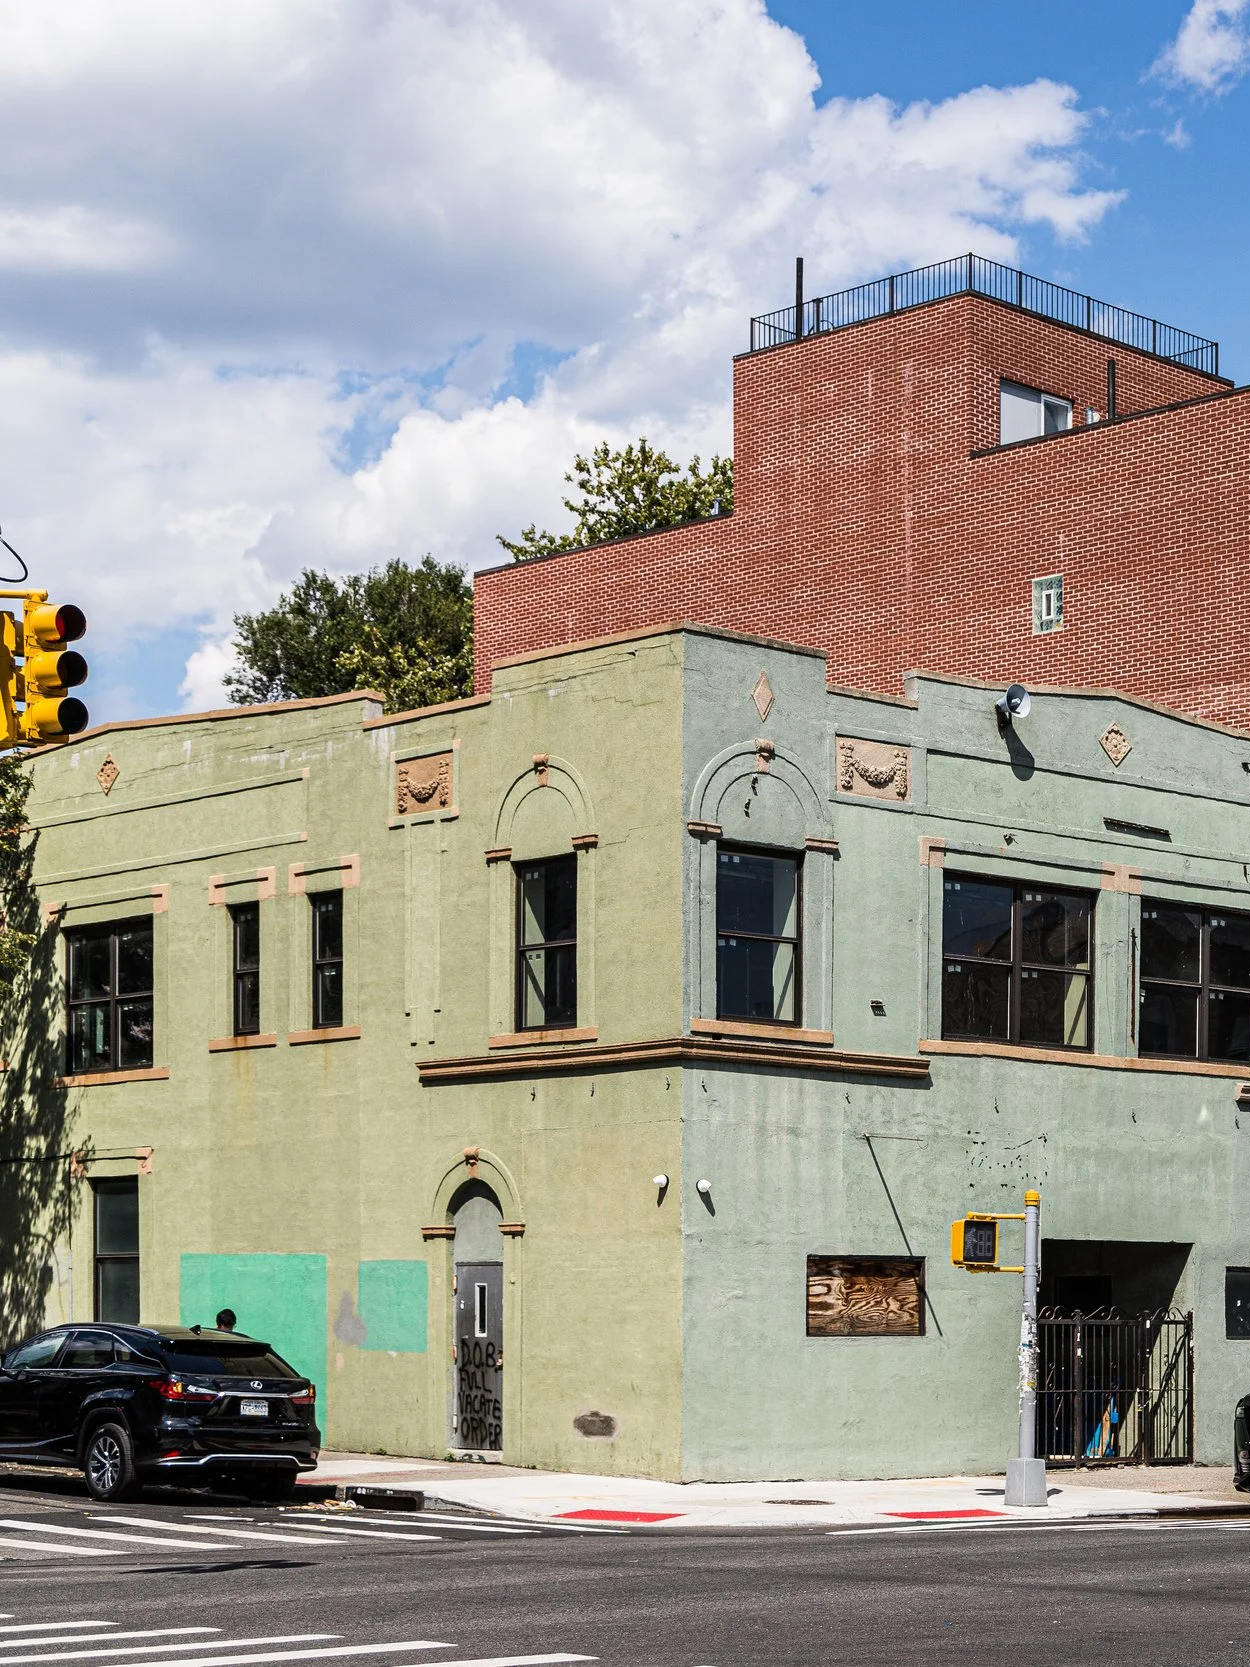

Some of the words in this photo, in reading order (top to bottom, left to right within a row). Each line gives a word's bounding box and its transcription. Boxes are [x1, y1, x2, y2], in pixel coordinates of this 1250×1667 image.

[459, 1368, 492, 1393] FULL
[458, 1391, 501, 1420] VACATE
[461, 1416, 502, 1450] ORDER
